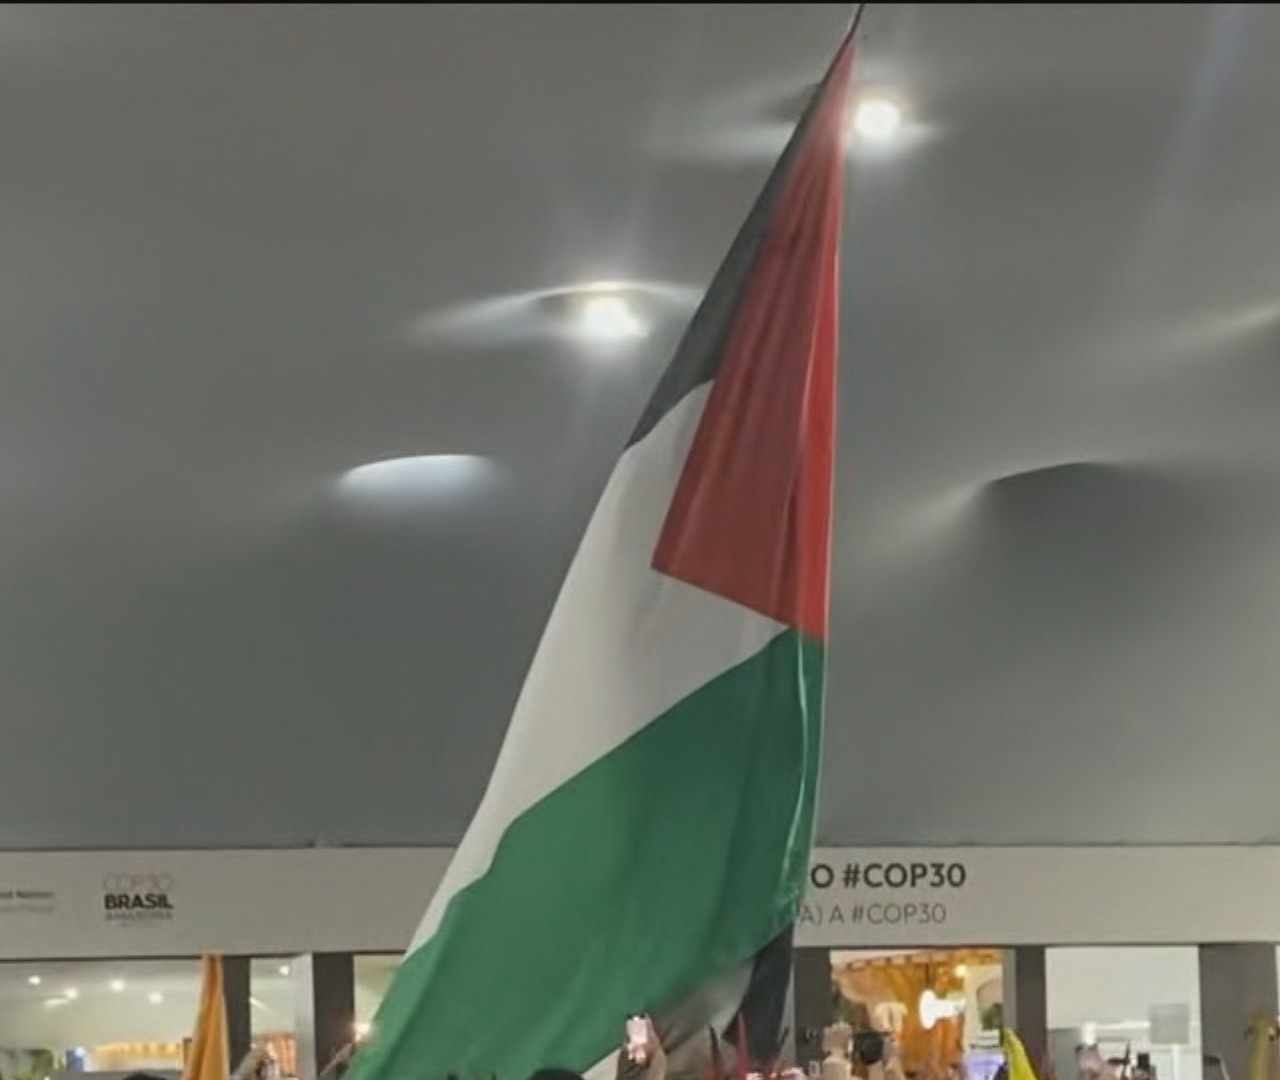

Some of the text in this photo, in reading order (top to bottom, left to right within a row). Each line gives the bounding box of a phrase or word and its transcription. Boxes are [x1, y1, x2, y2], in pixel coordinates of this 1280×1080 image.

[810, 863, 966, 889] O #COP30
[104, 893, 173, 910] BRASIL
[852, 903, 947, 925] #COP30
